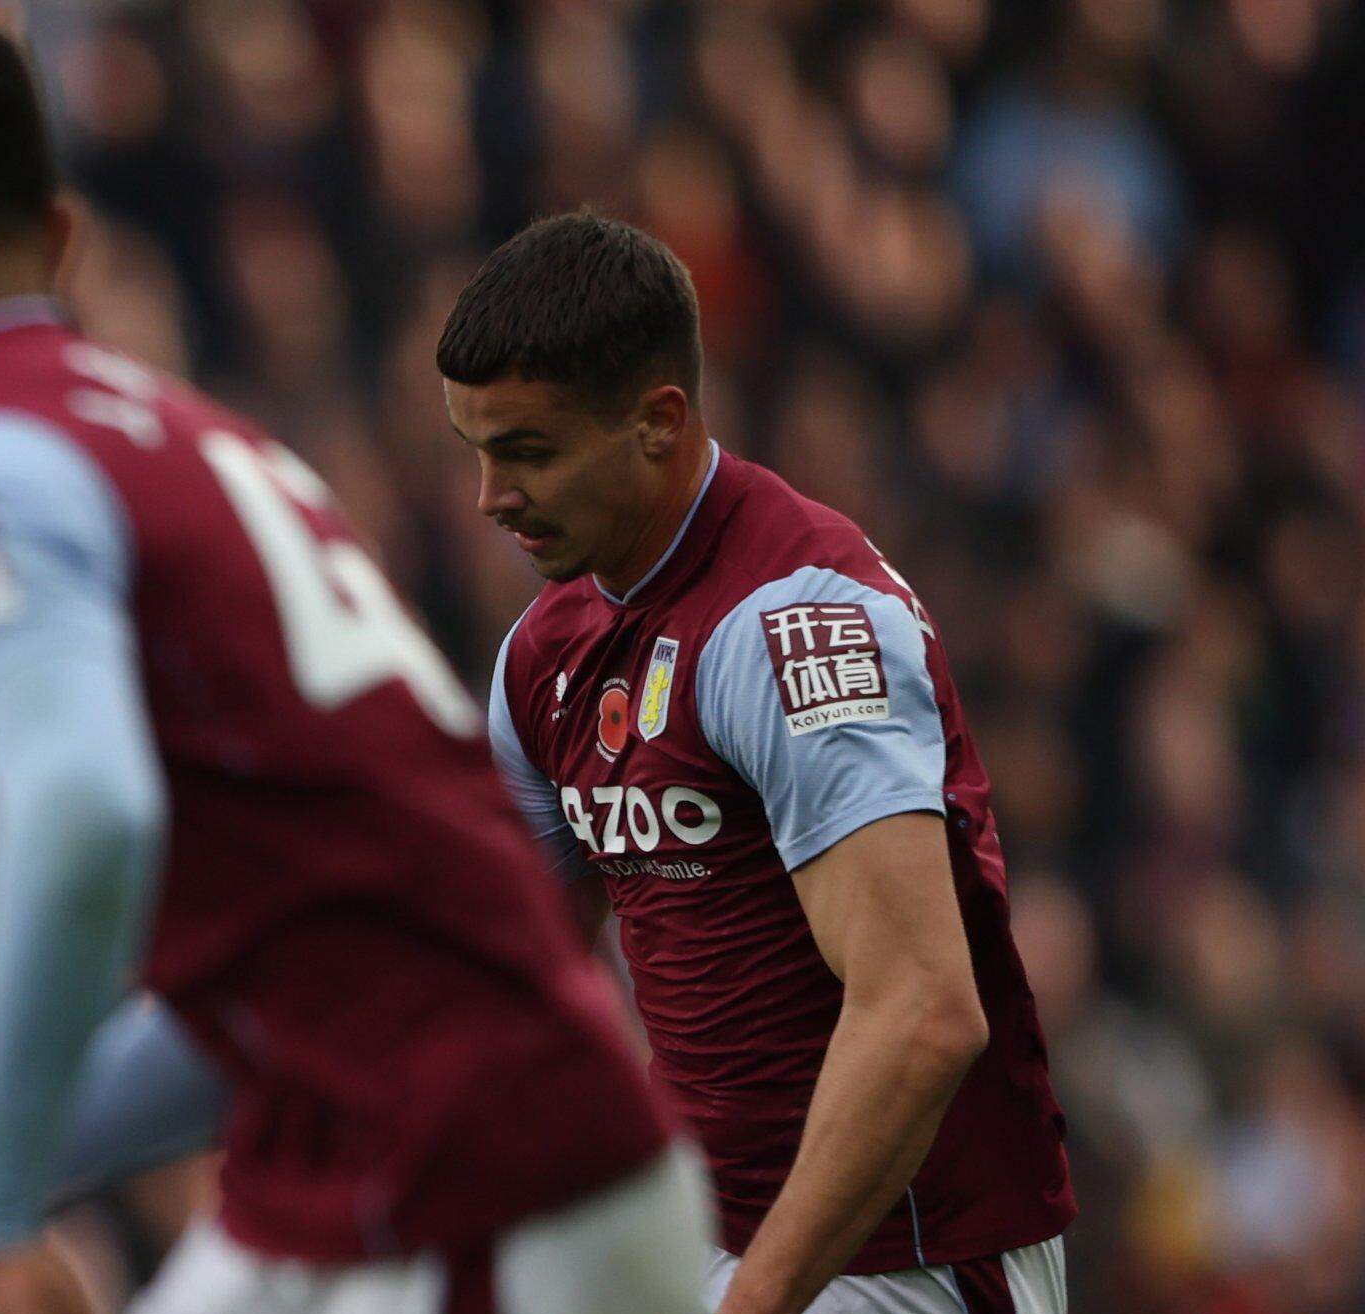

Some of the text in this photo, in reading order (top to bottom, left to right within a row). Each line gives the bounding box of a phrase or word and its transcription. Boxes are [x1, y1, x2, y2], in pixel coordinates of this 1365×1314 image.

[765, 606, 871, 656] 开云
[781, 649, 881, 709] 体育
[551, 780, 723, 854] AZOO
